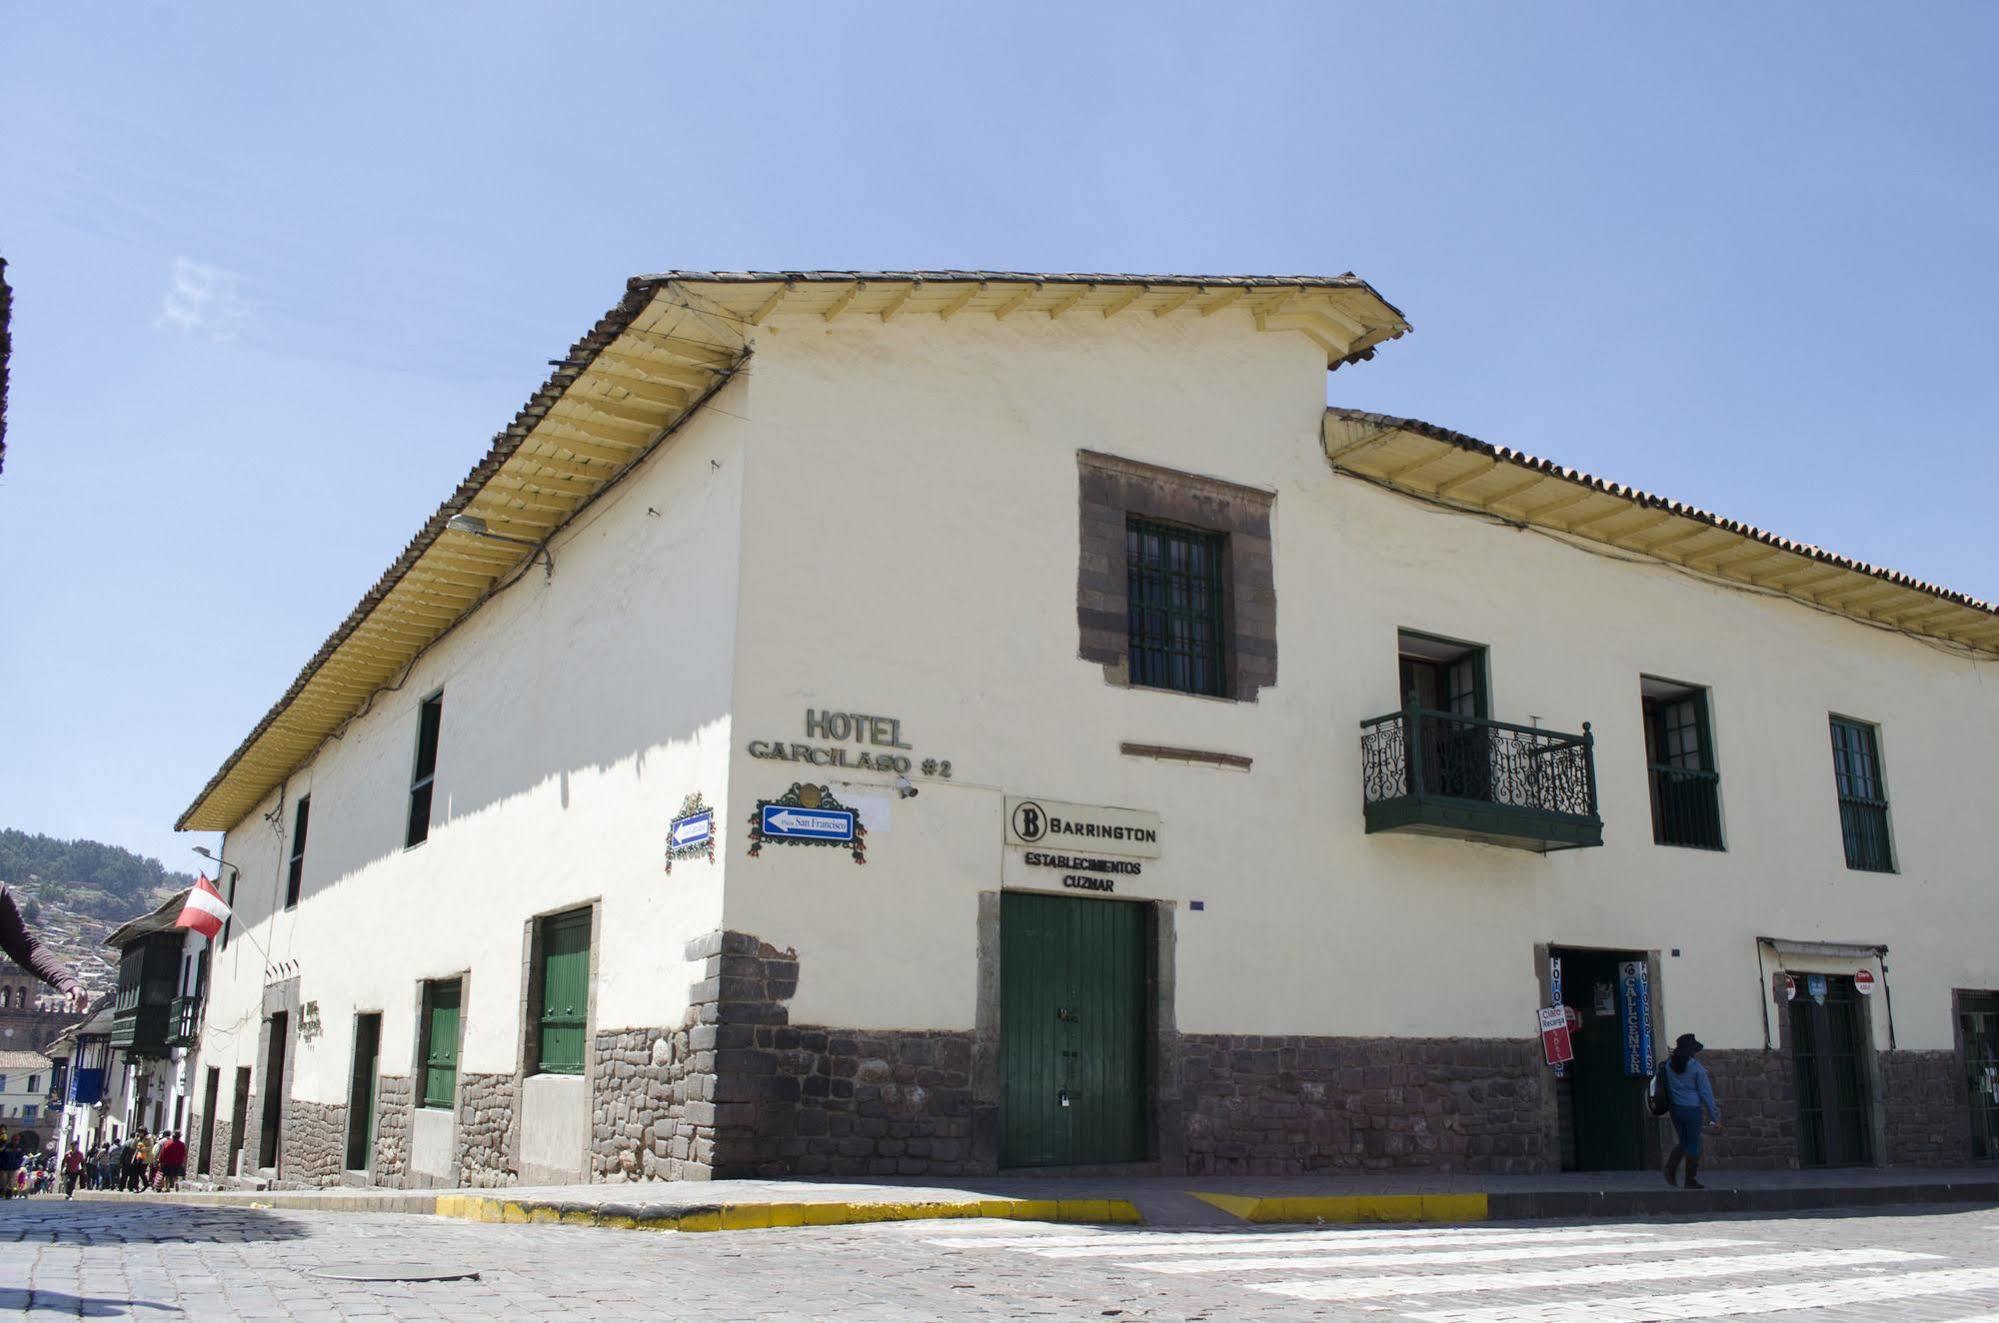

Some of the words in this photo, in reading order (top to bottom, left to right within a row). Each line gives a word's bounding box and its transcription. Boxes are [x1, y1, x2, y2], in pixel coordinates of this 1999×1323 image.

[807, 708, 913, 750] HOTEL
[748, 740, 912, 774] GARCILASO
[920, 758, 952, 778] #2
[795, 816, 810, 828] San
[811, 817, 847, 831] Francisco
[1050, 817, 1157, 843] BARRINGTON
[1025, 852, 1142, 876] ESTABLECIMIENTOS
[1063, 874, 1115, 893] CUZMAR
